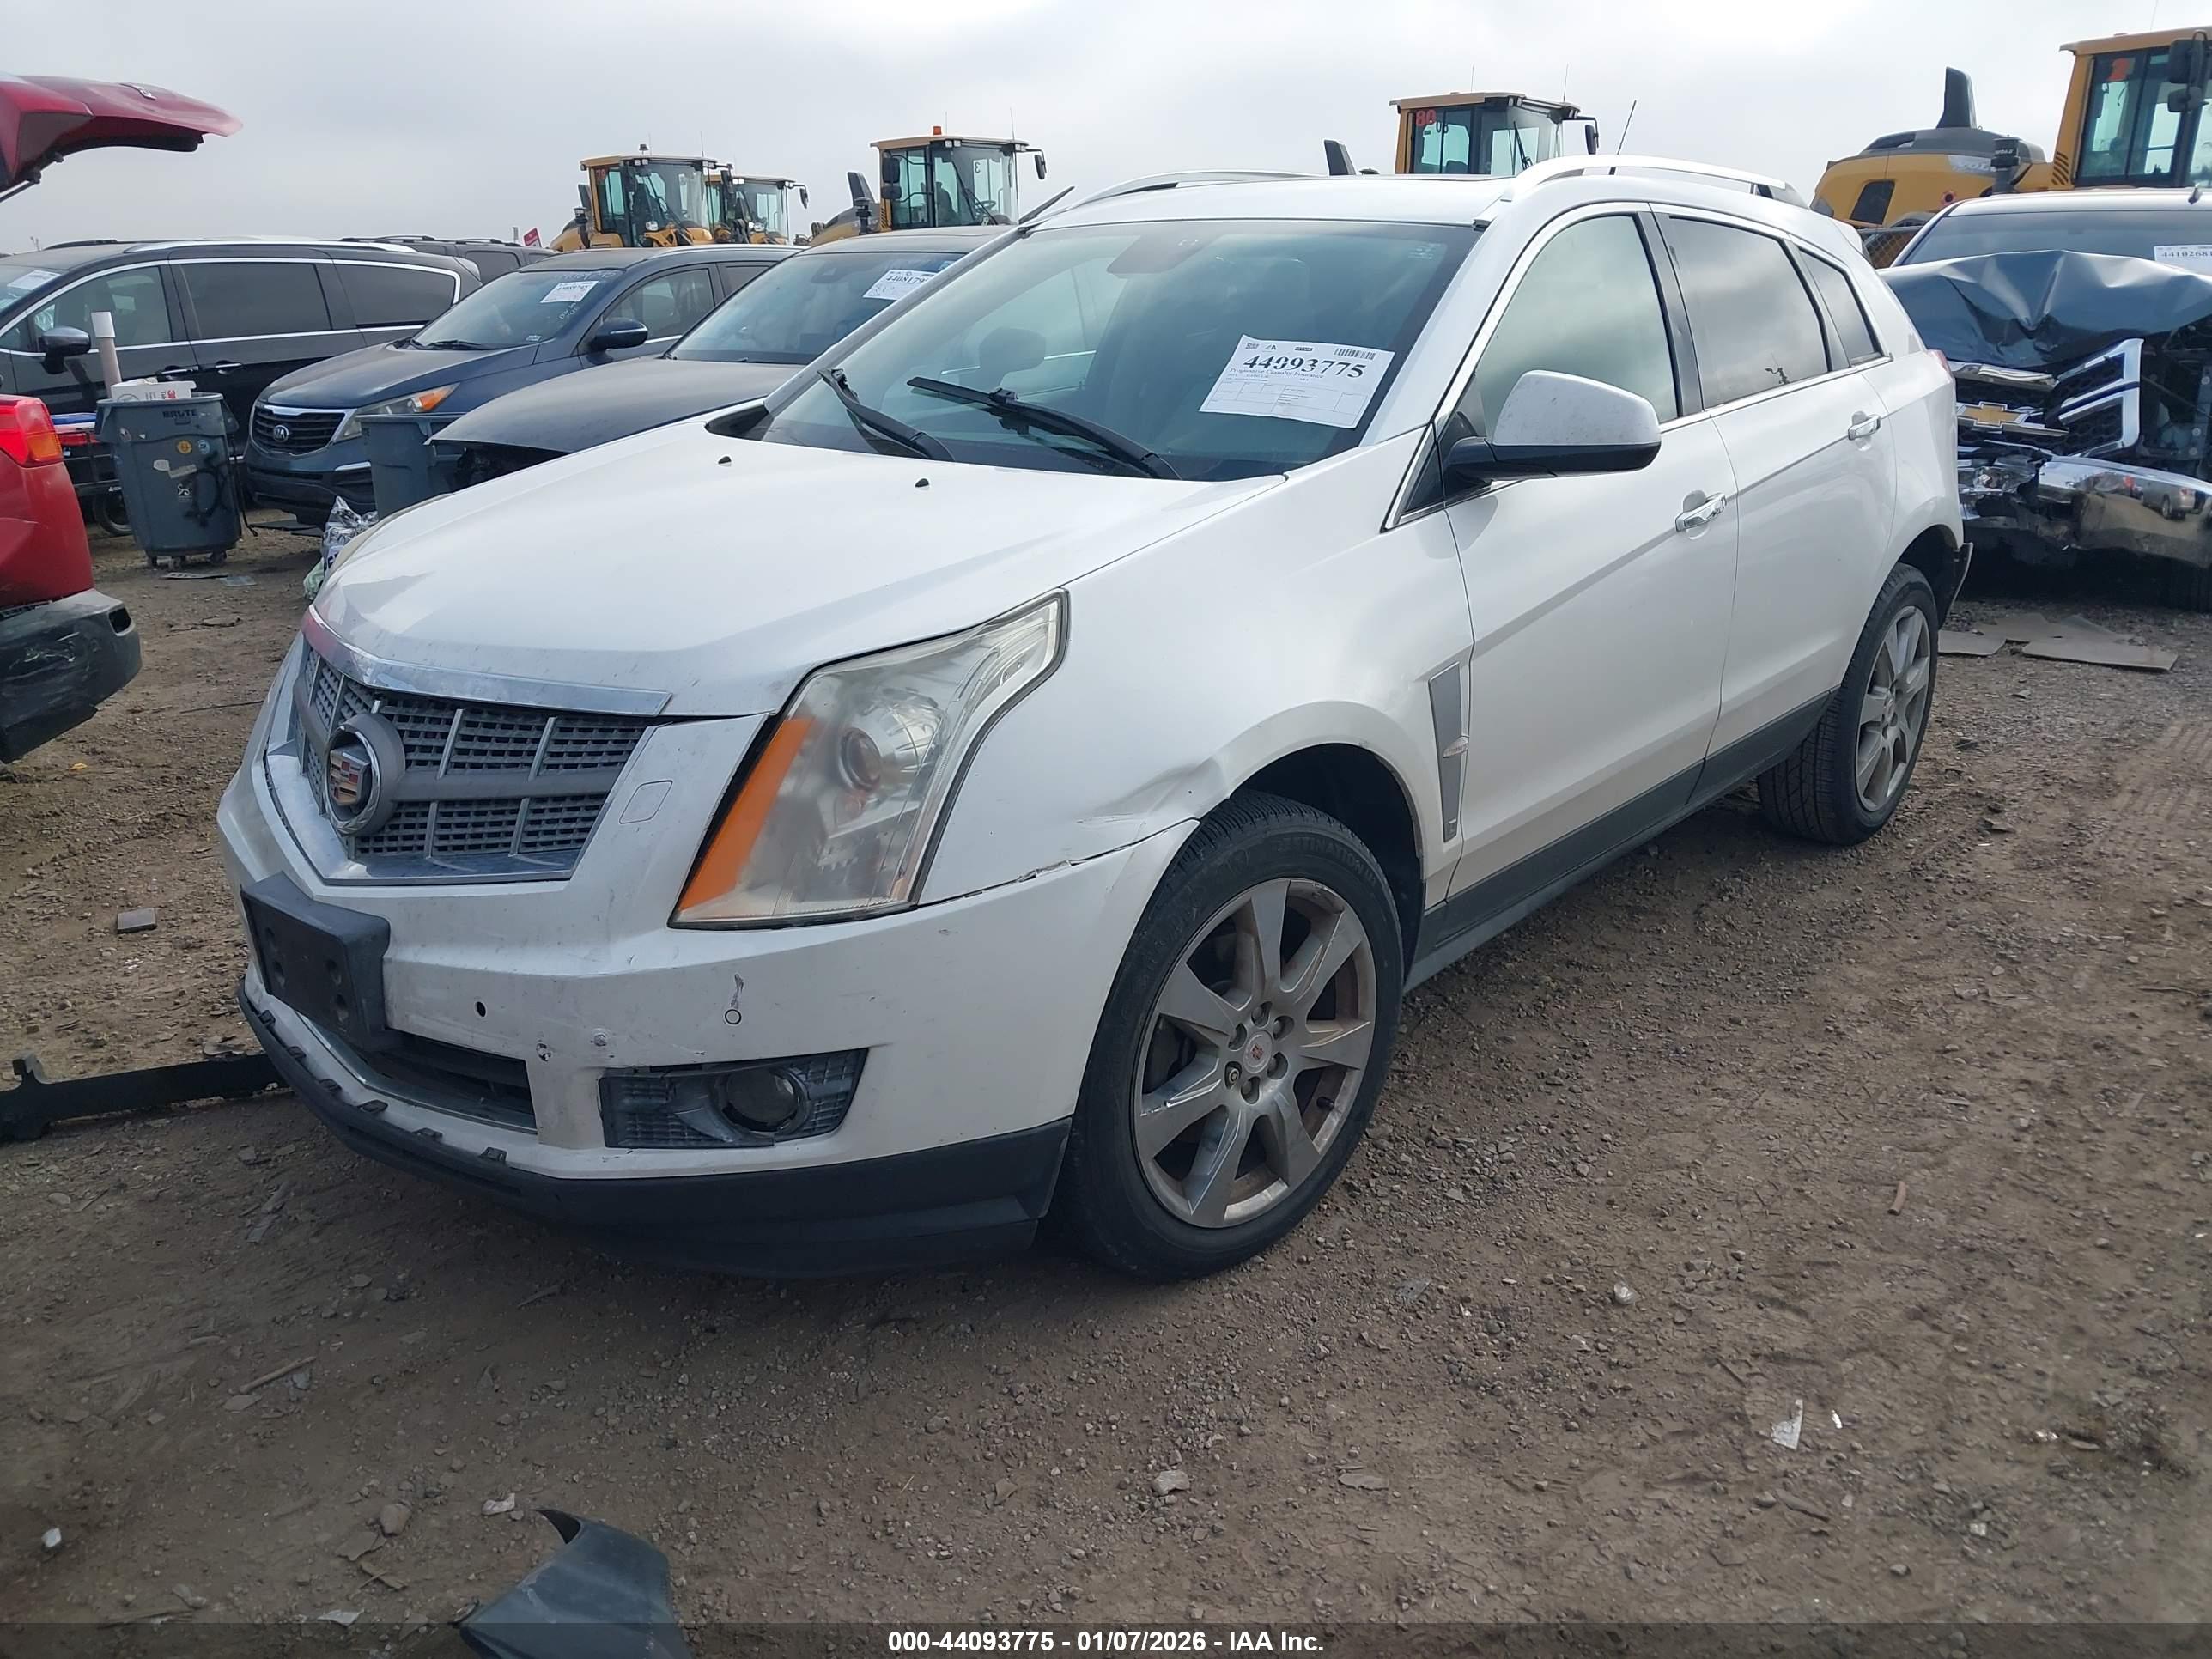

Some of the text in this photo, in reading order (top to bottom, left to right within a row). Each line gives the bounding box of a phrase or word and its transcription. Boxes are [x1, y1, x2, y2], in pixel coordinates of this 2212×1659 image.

[1416, 110, 1437, 126] 80
[1243, 355, 1366, 378] 44093775
[162, 409, 198, 418] BRUTE
